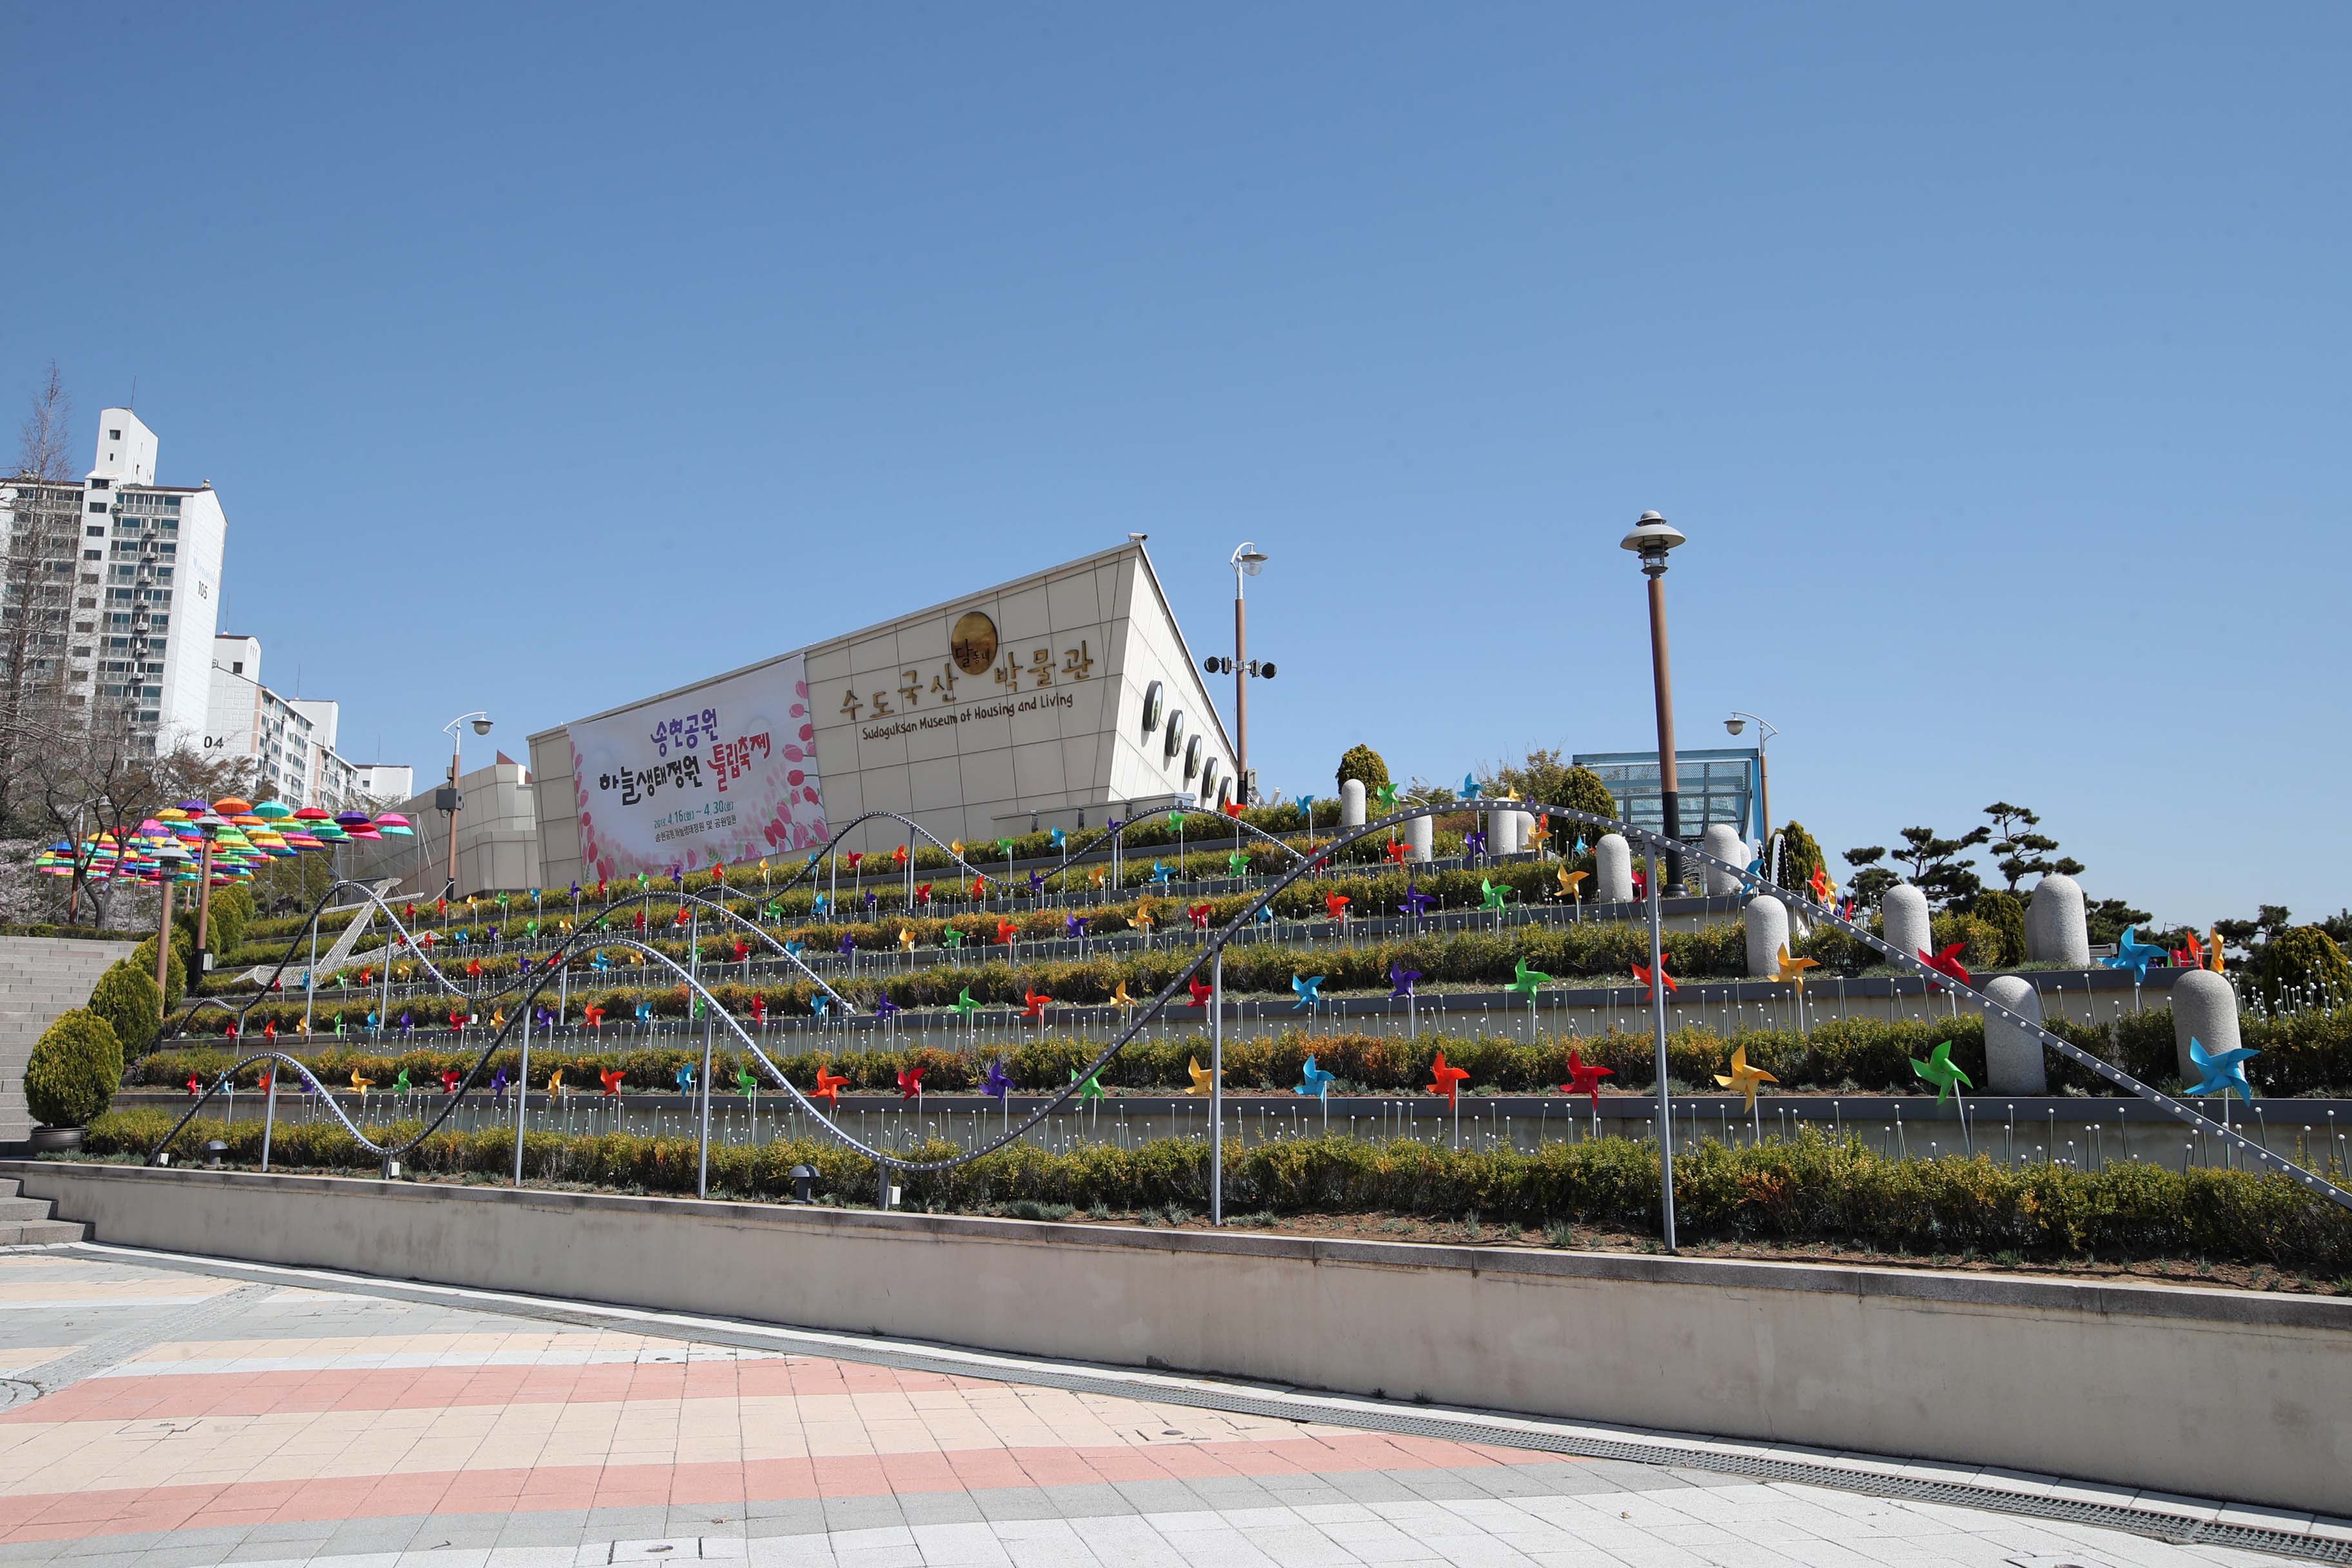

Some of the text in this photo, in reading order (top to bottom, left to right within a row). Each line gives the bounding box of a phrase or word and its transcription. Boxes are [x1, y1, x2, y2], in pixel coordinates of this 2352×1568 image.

[198, 580, 208, 600] 105
[839, 638, 1094, 721] 수도국산 달동네 박물관
[650, 708, 718, 758] 송현공원
[863, 692, 1073, 740] Sudoguksan Museum of Housing and Living
[599, 755, 703, 806] 하늘생태정원
[655, 828, 675, 843] 송현공원
